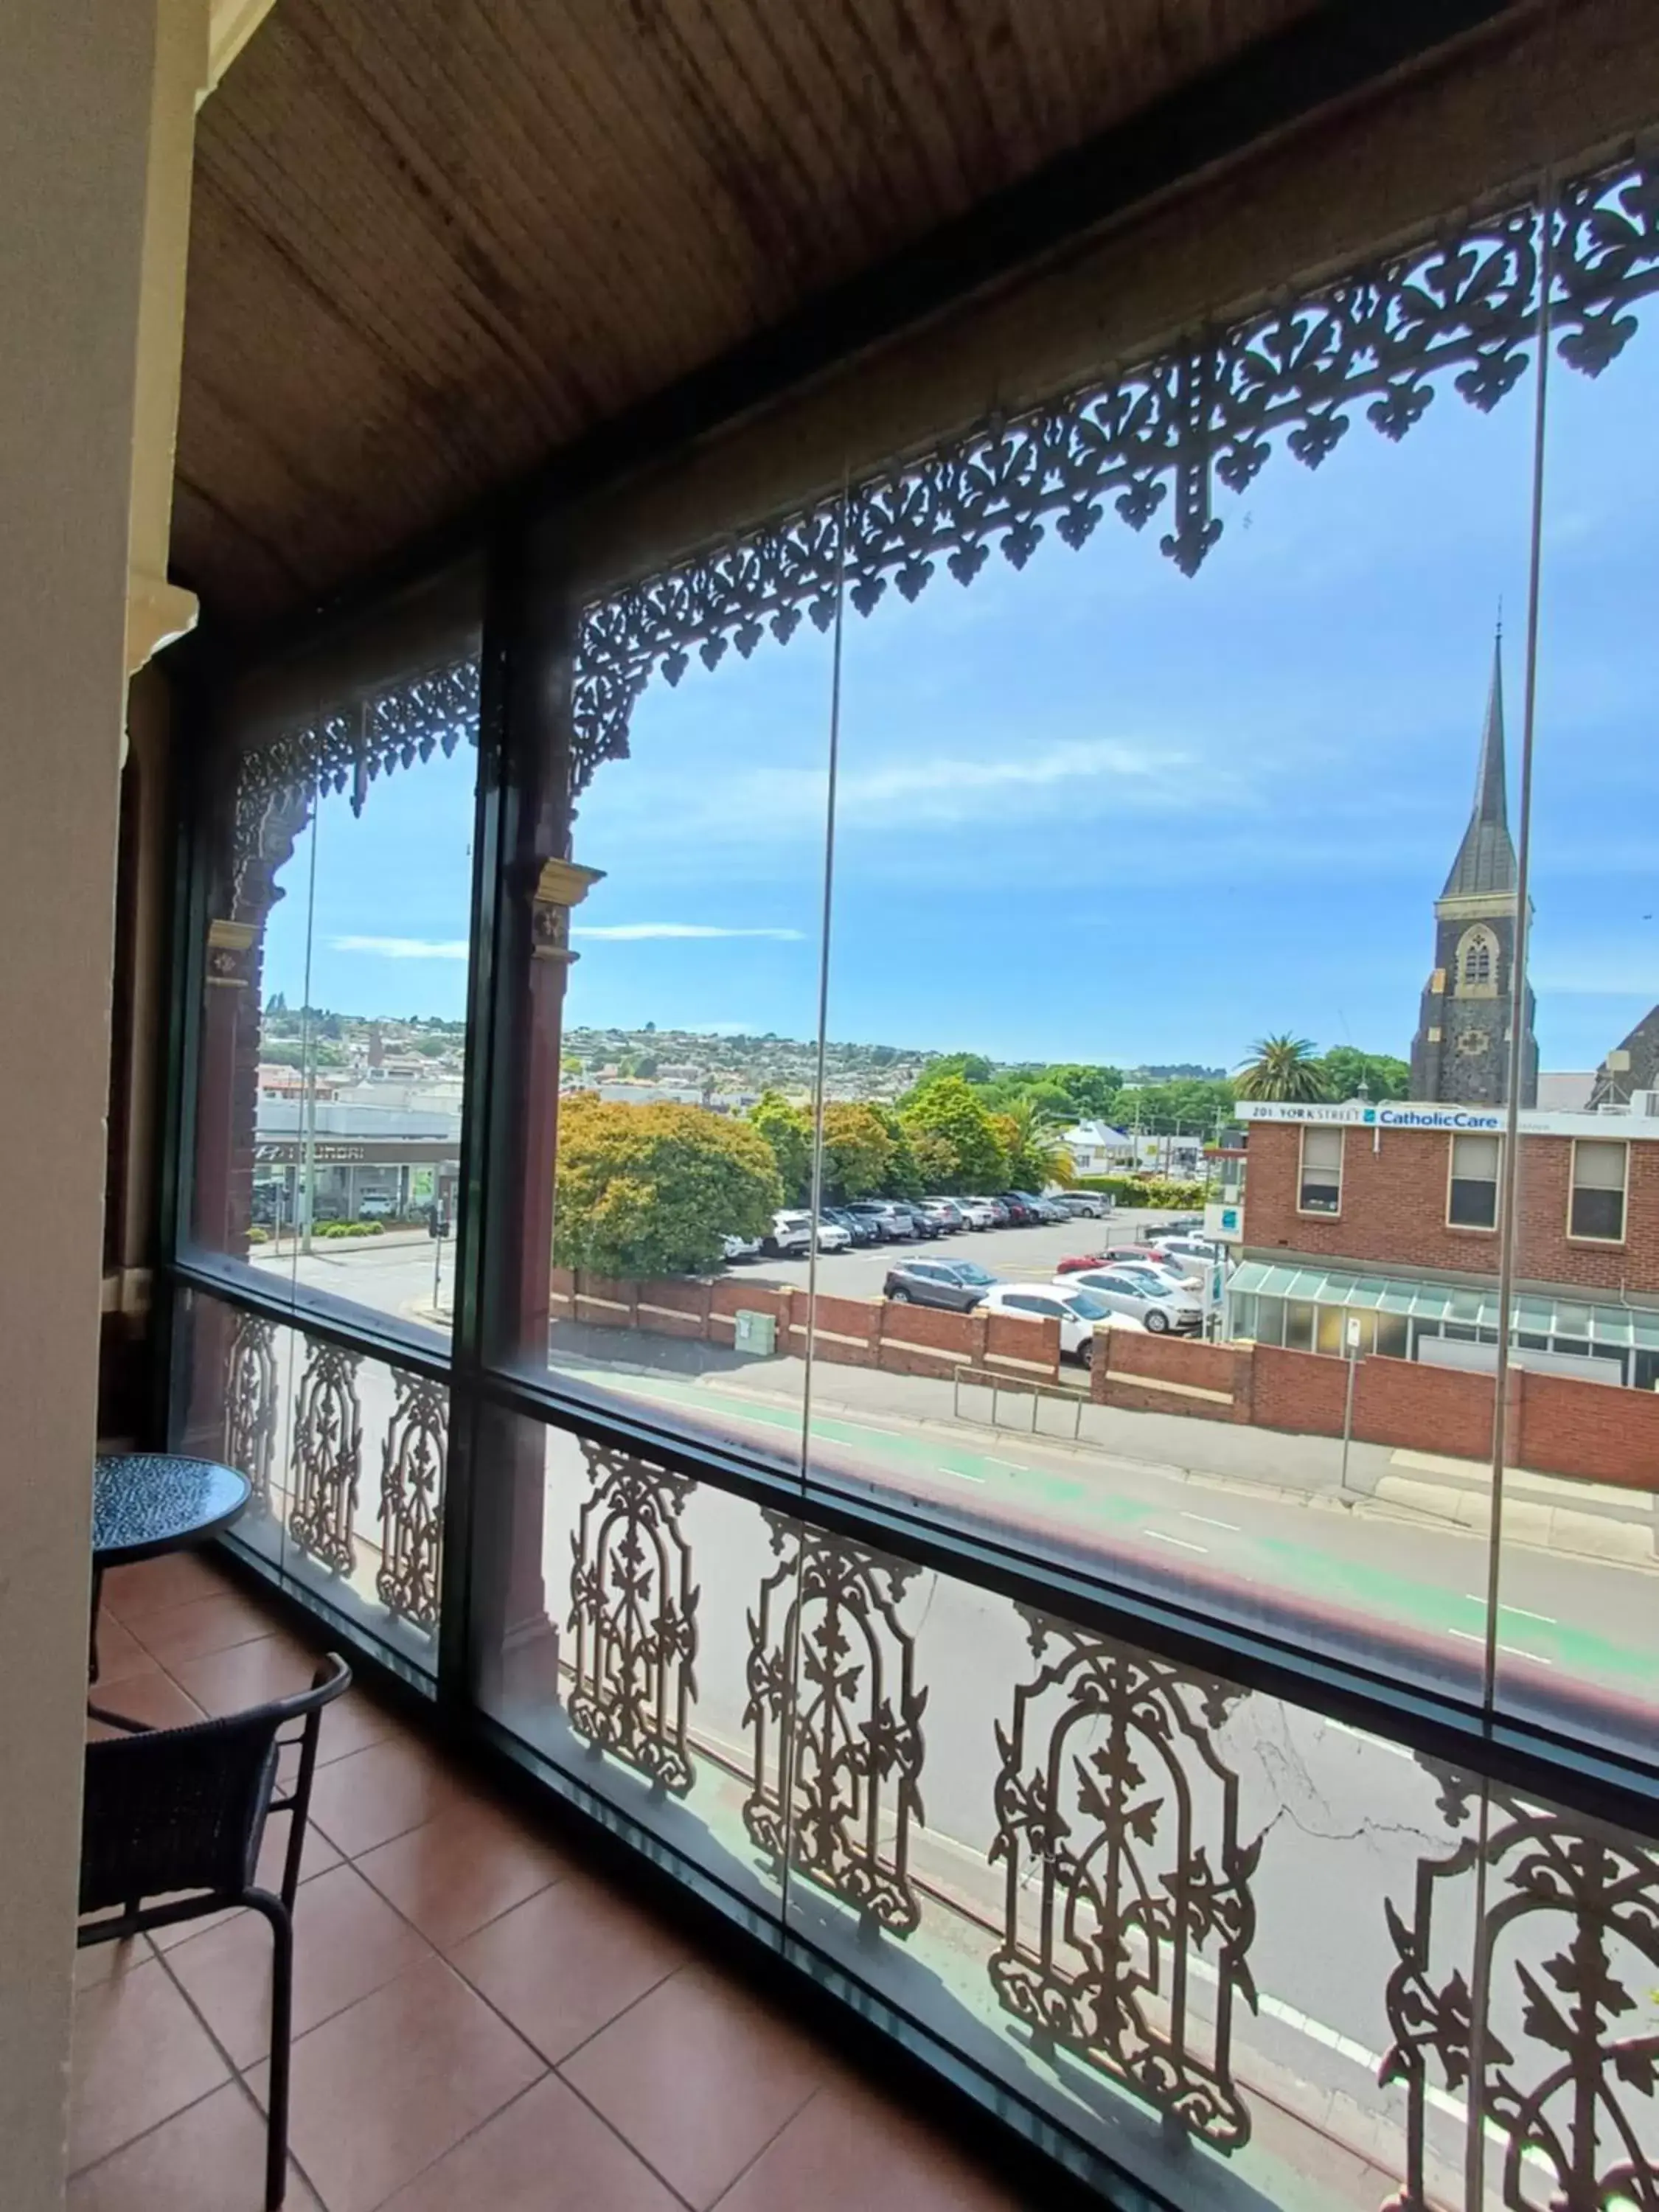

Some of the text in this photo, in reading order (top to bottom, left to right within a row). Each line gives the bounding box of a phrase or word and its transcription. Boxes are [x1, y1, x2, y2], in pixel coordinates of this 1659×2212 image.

[1253, 1107, 1360, 1121] 201 YORK STREET
[1380, 1110, 1498, 1129] CatholicCare
